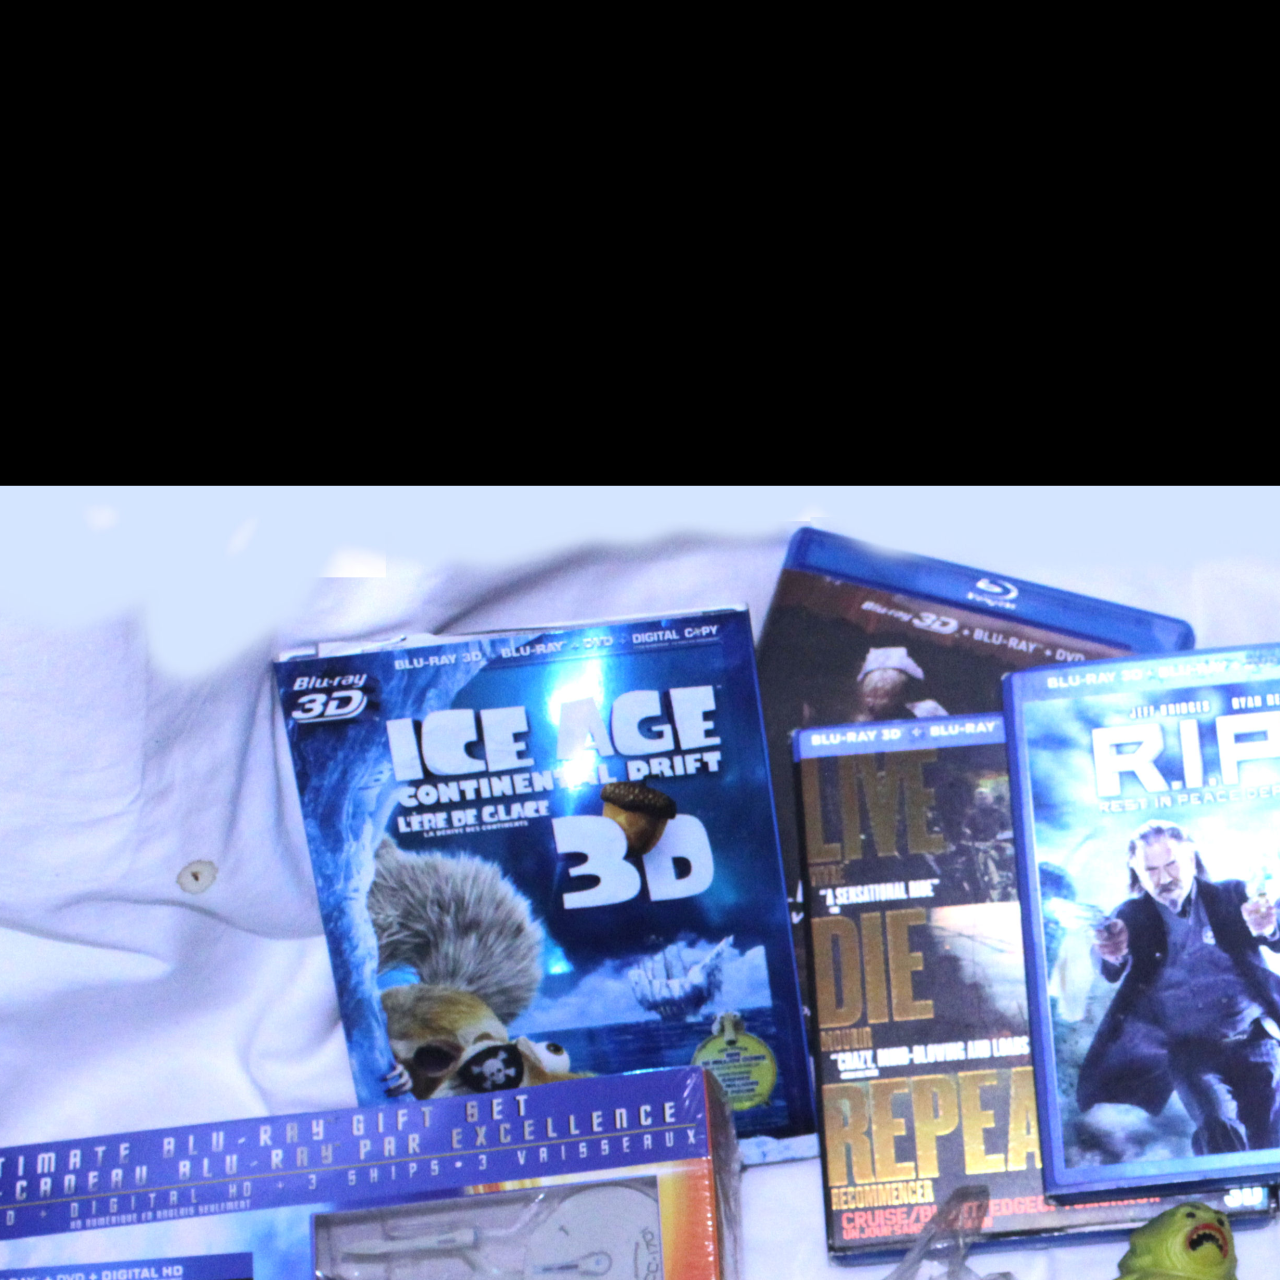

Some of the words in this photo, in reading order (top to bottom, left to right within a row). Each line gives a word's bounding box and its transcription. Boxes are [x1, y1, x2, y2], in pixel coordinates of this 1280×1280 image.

[912, 610, 959, 635] 3D
[973, 628, 1038, 655] BLU-RAY
[393, 653, 457, 671] BLU-RAY
[462, 651, 483, 663] 3D
[501, 639, 566, 659] BLU-RAY
[582, 635, 614, 649] DVD
[632, 629, 680, 644] DIGITAL
[293, 673, 368, 691] Blu-ray
[1047, 671, 1117, 690] BLU-RAY
[1121, 668, 1143, 682] 3D
[291, 689, 369, 723] 3D
[386, 705, 535, 781] ICE
[557, 684, 722, 761] AGE
[811, 730, 877, 747] BLU-RAY
[881, 728, 902, 741] 3D
[929, 721, 998, 738] BLU-RAY
[627, 750, 722, 782] DRIFT
[450, 808, 479, 828] DE
[481, 800, 550, 823] GLACE
[800, 748, 948, 863] LIVE
[1099, 797, 1148, 814] REST
[1154, 796, 1173, 809] IN
[1177, 789, 1241, 806] PEACE
[552, 814, 715, 910] 3D
[835, 881, 909, 905] SENSATIONAL
[810, 906, 935, 1029] DIE
[163, 1118, 325, 1159] BLU-RAY
[352, 1106, 433, 1136] GIFT
[466, 1094, 528, 1122] SET
[179, 1143, 333, 1181] BLU-RAY
[360, 1133, 421, 1160] PAR
[452, 1101, 676, 1149] EXCELLENCE
[70, 1188, 198, 1219] DIGITAL
[228, 1181, 252, 1198] HD
[308, 1174, 317, 1190] 3
[348, 1159, 440, 1186] SHIPS
[478, 1155, 488, 1170] 3
[517, 1128, 697, 1165] VAISSEAUX
[831, 1179, 935, 1211] RECOMMENCER
[162, 1265, 184, 1278] HD
